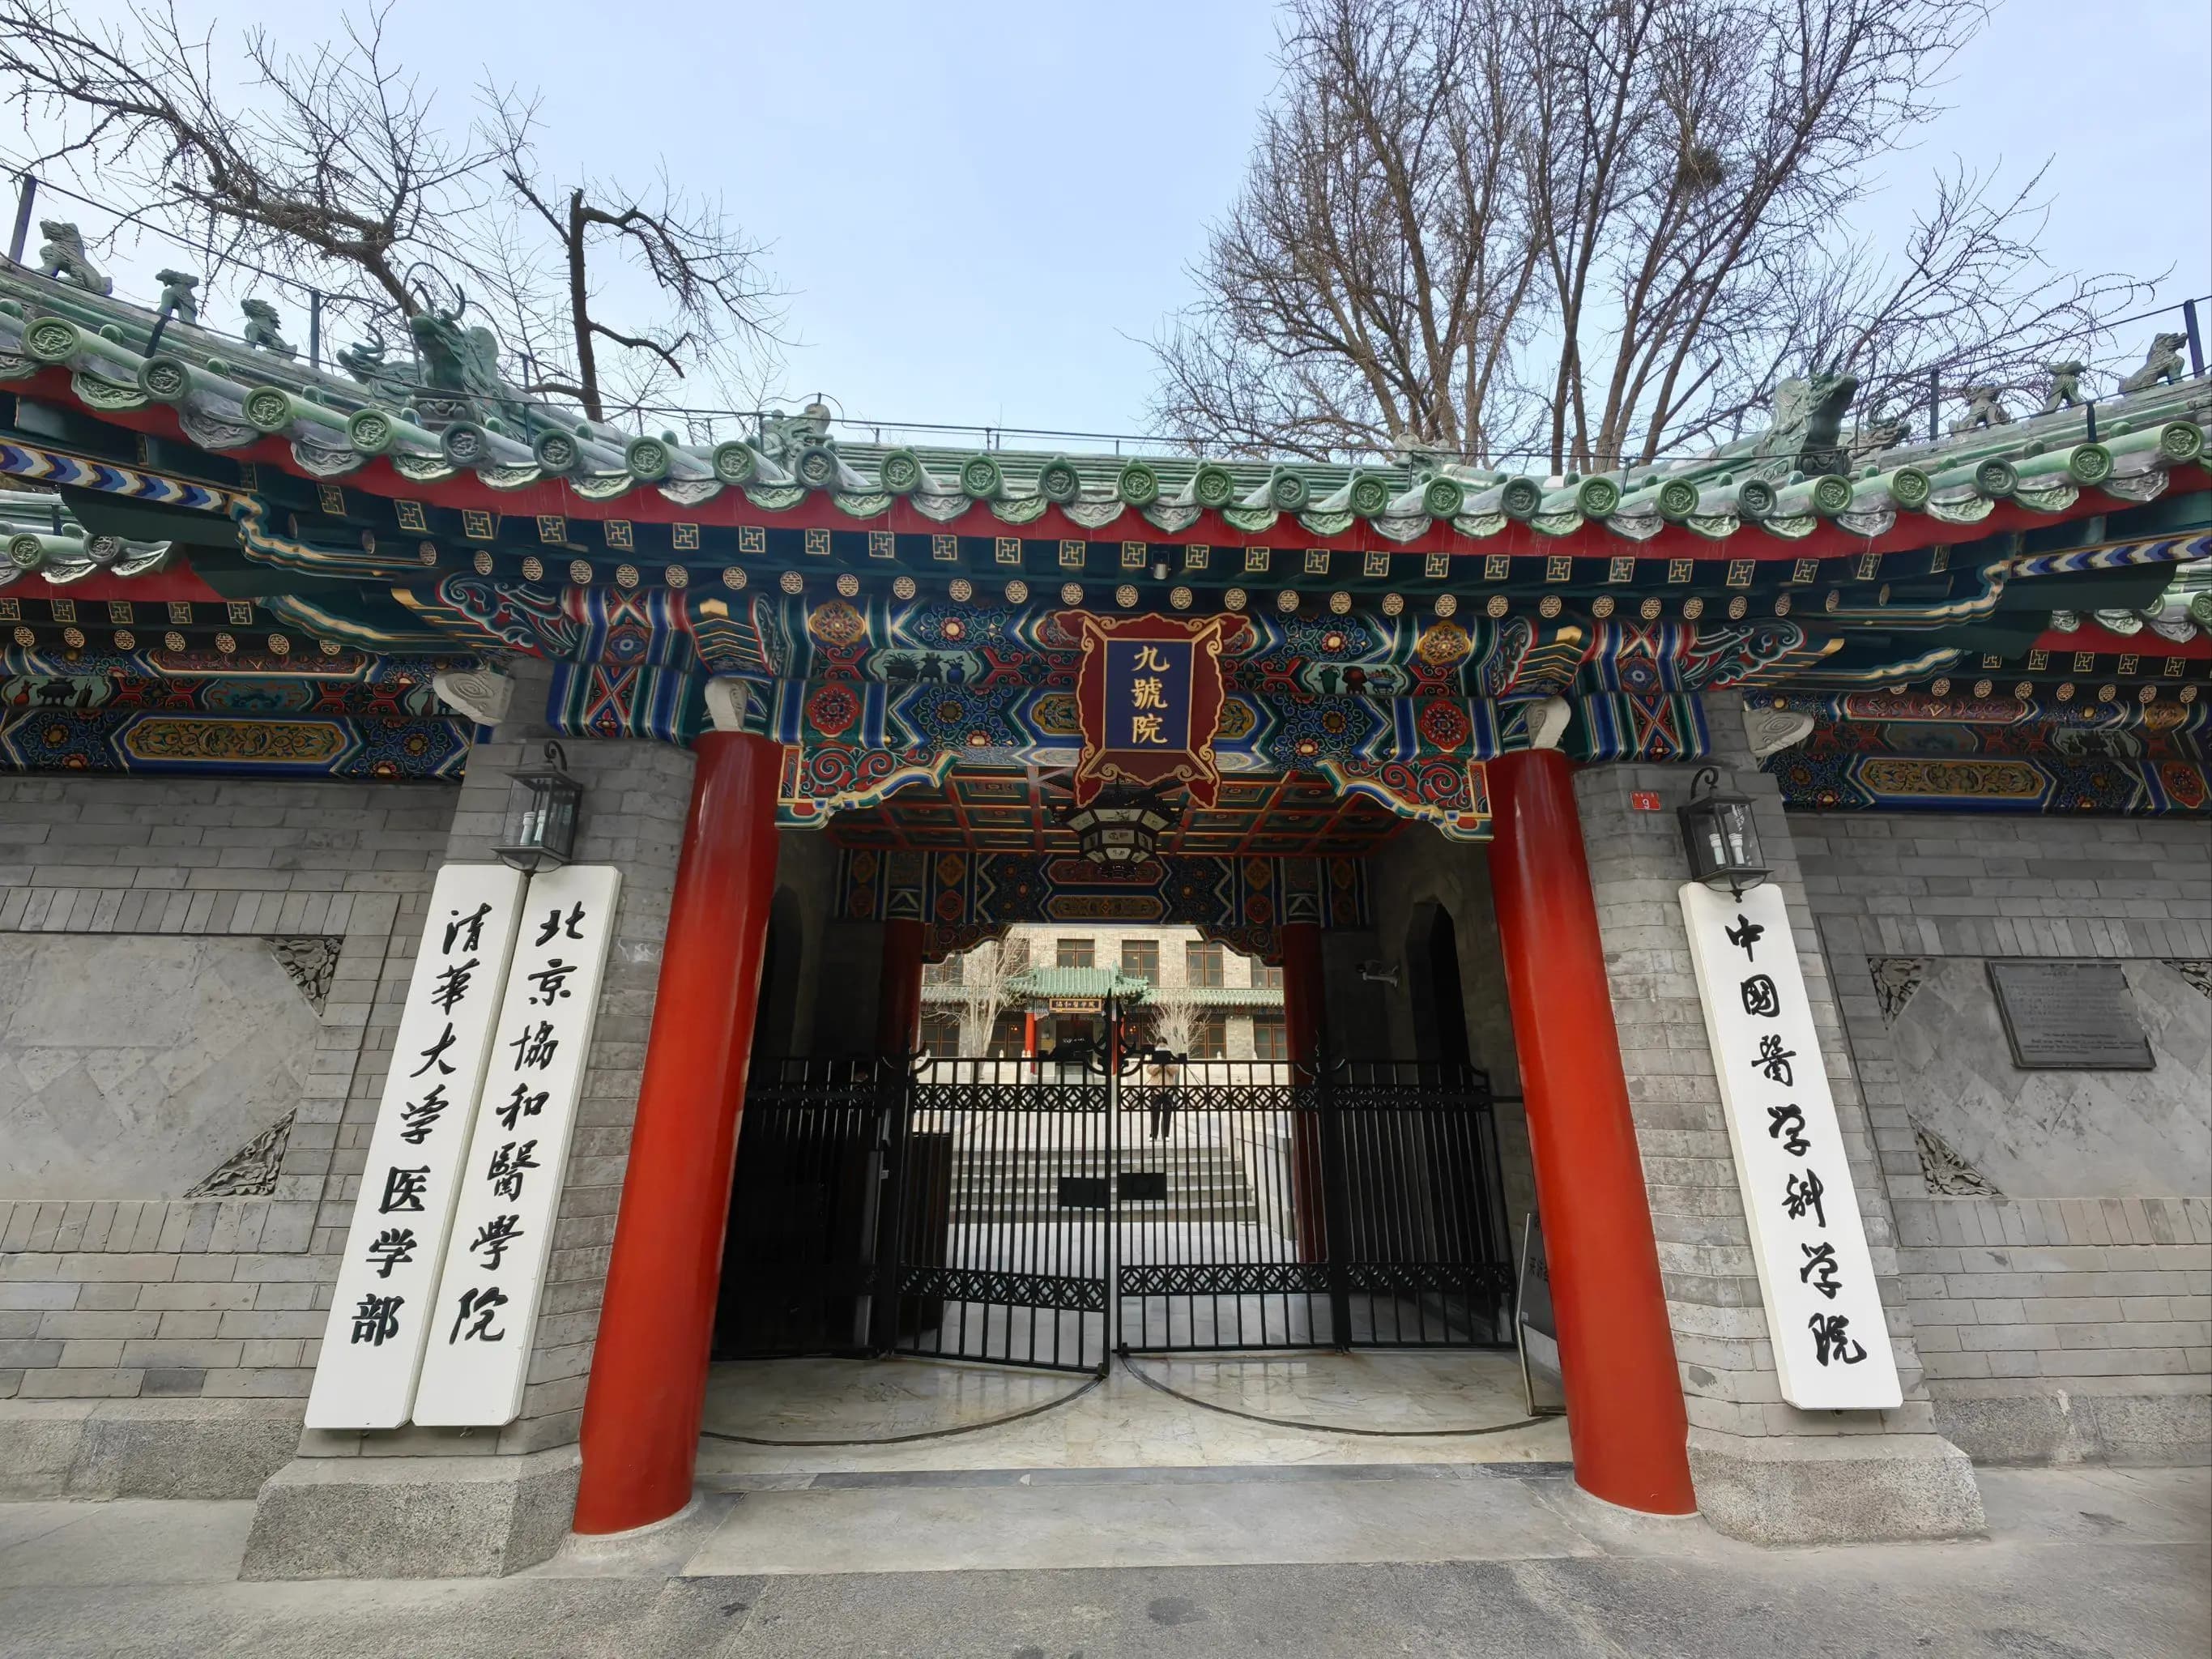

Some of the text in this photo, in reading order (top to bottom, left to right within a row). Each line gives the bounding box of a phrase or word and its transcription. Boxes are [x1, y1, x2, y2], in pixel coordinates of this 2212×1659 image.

[1131, 645, 1171, 744] 九號院
[1642, 798, 1650, 808] 9
